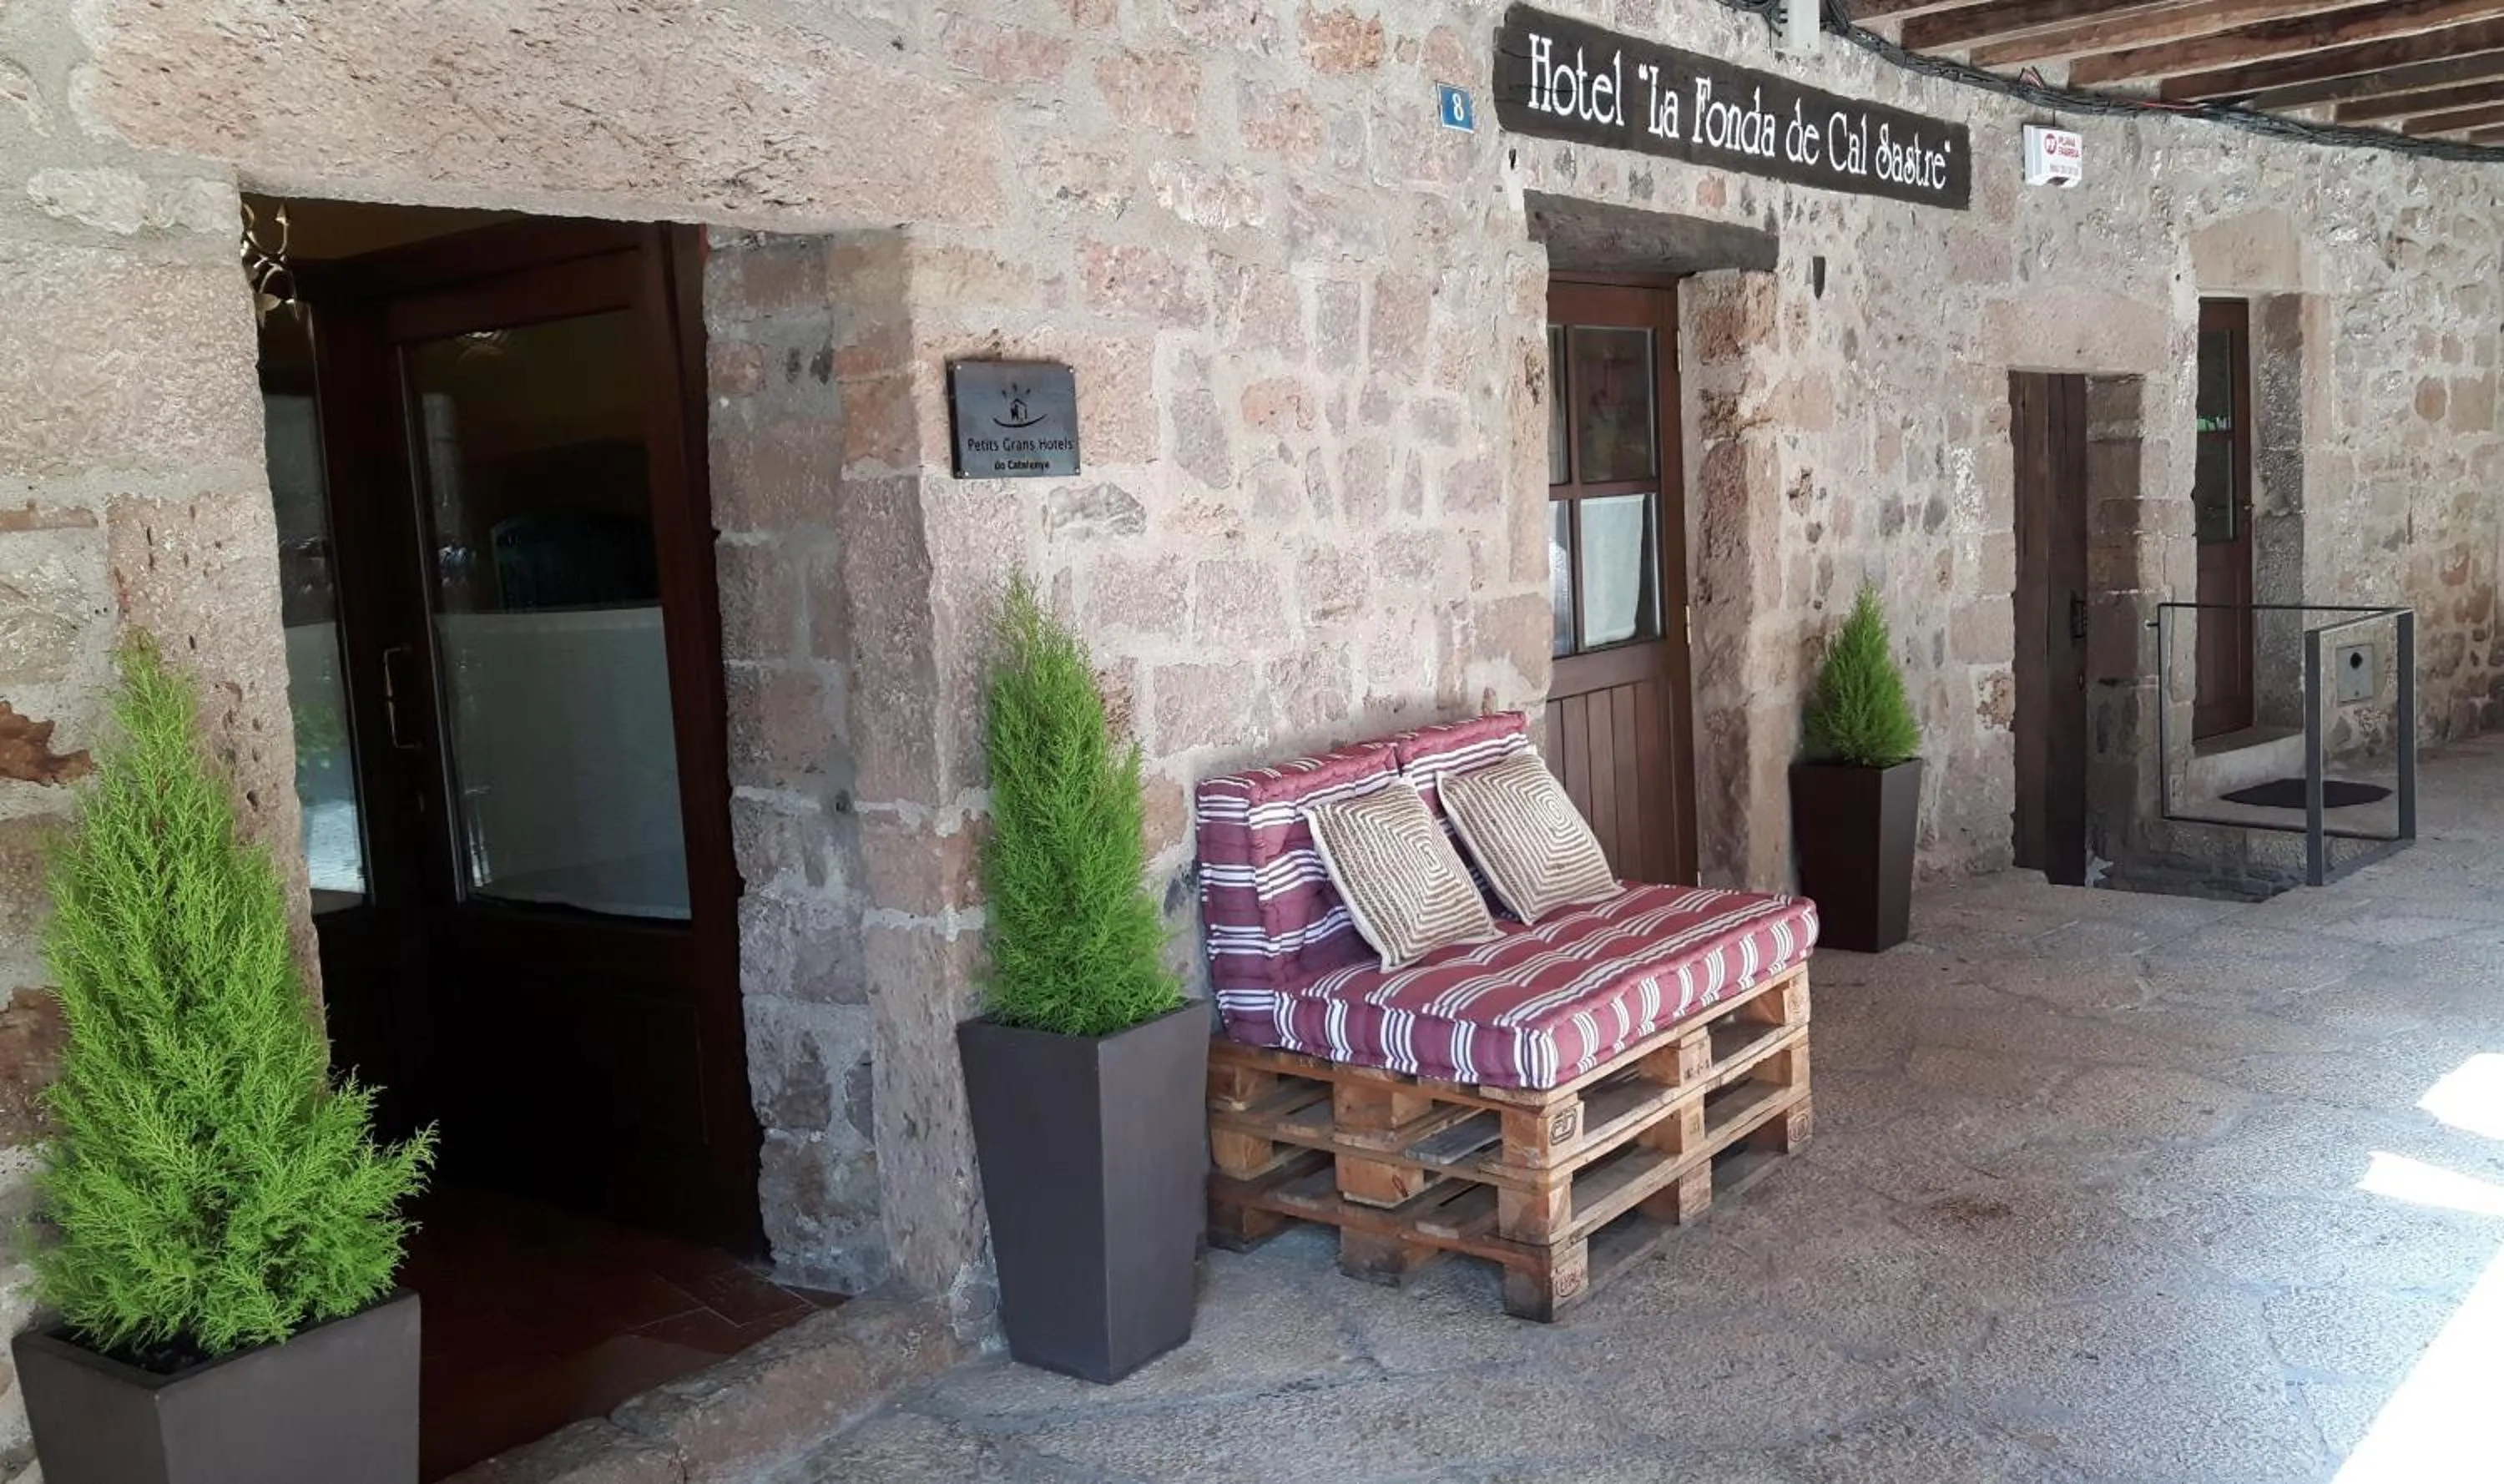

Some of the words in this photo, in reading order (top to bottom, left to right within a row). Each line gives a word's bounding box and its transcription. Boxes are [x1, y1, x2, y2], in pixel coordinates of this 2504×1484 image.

[1452, 93, 1464, 121] 8
[1528, 33, 1625, 127] Hotel
[1692, 76, 1776, 158] Fonda
[1785, 97, 1820, 166] de
[1828, 111, 1868, 175] Cal
[967, 437, 999, 452] Petits
[1002, 437, 1035, 452] Grans
[1038, 436, 1074, 451] Hotels
